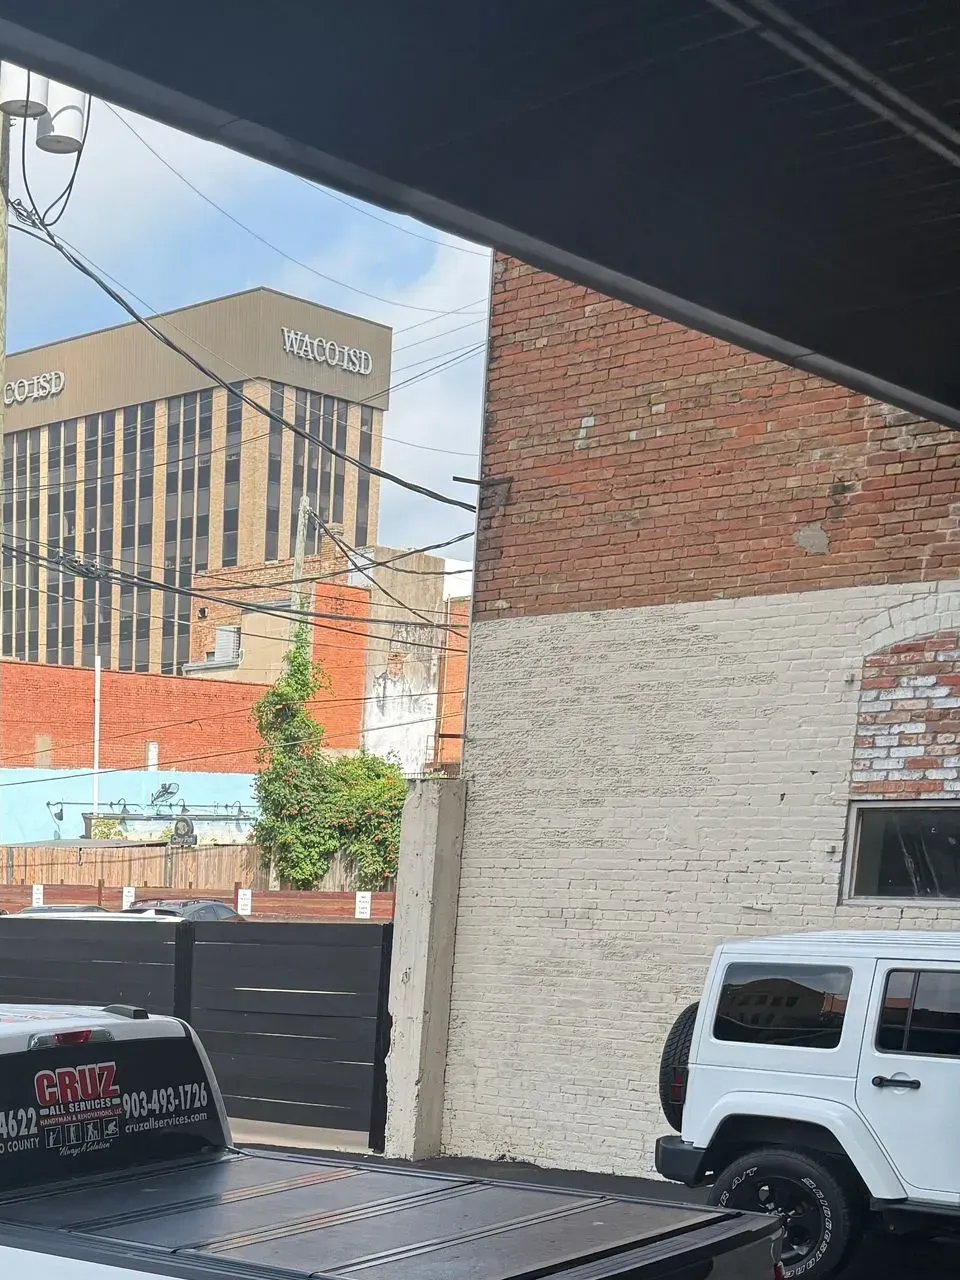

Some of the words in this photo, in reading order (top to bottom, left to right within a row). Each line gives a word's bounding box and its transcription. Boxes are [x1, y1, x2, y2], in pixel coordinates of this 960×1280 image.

[281, 327, 339, 366] WACO
[340, 345, 373, 375] ISD
[32, 371, 65, 399] ISD
[34, 1061, 121, 1107] CRUZ
[49, 1105, 66, 1116] ALL
[69, 1097, 112, 1113] SERVICES
[122, 1082, 208, 1120] 903-493-1726
[40, 1115, 72, 1126] HANDYMAN
[125, 1112, 208, 1134] cruzallservices.com
[7, 1136, 40, 1154] COUNTY
[731, 1166, 758, 1190] A/T
[783, 1177, 833, 1279] BRIDGESTONE
